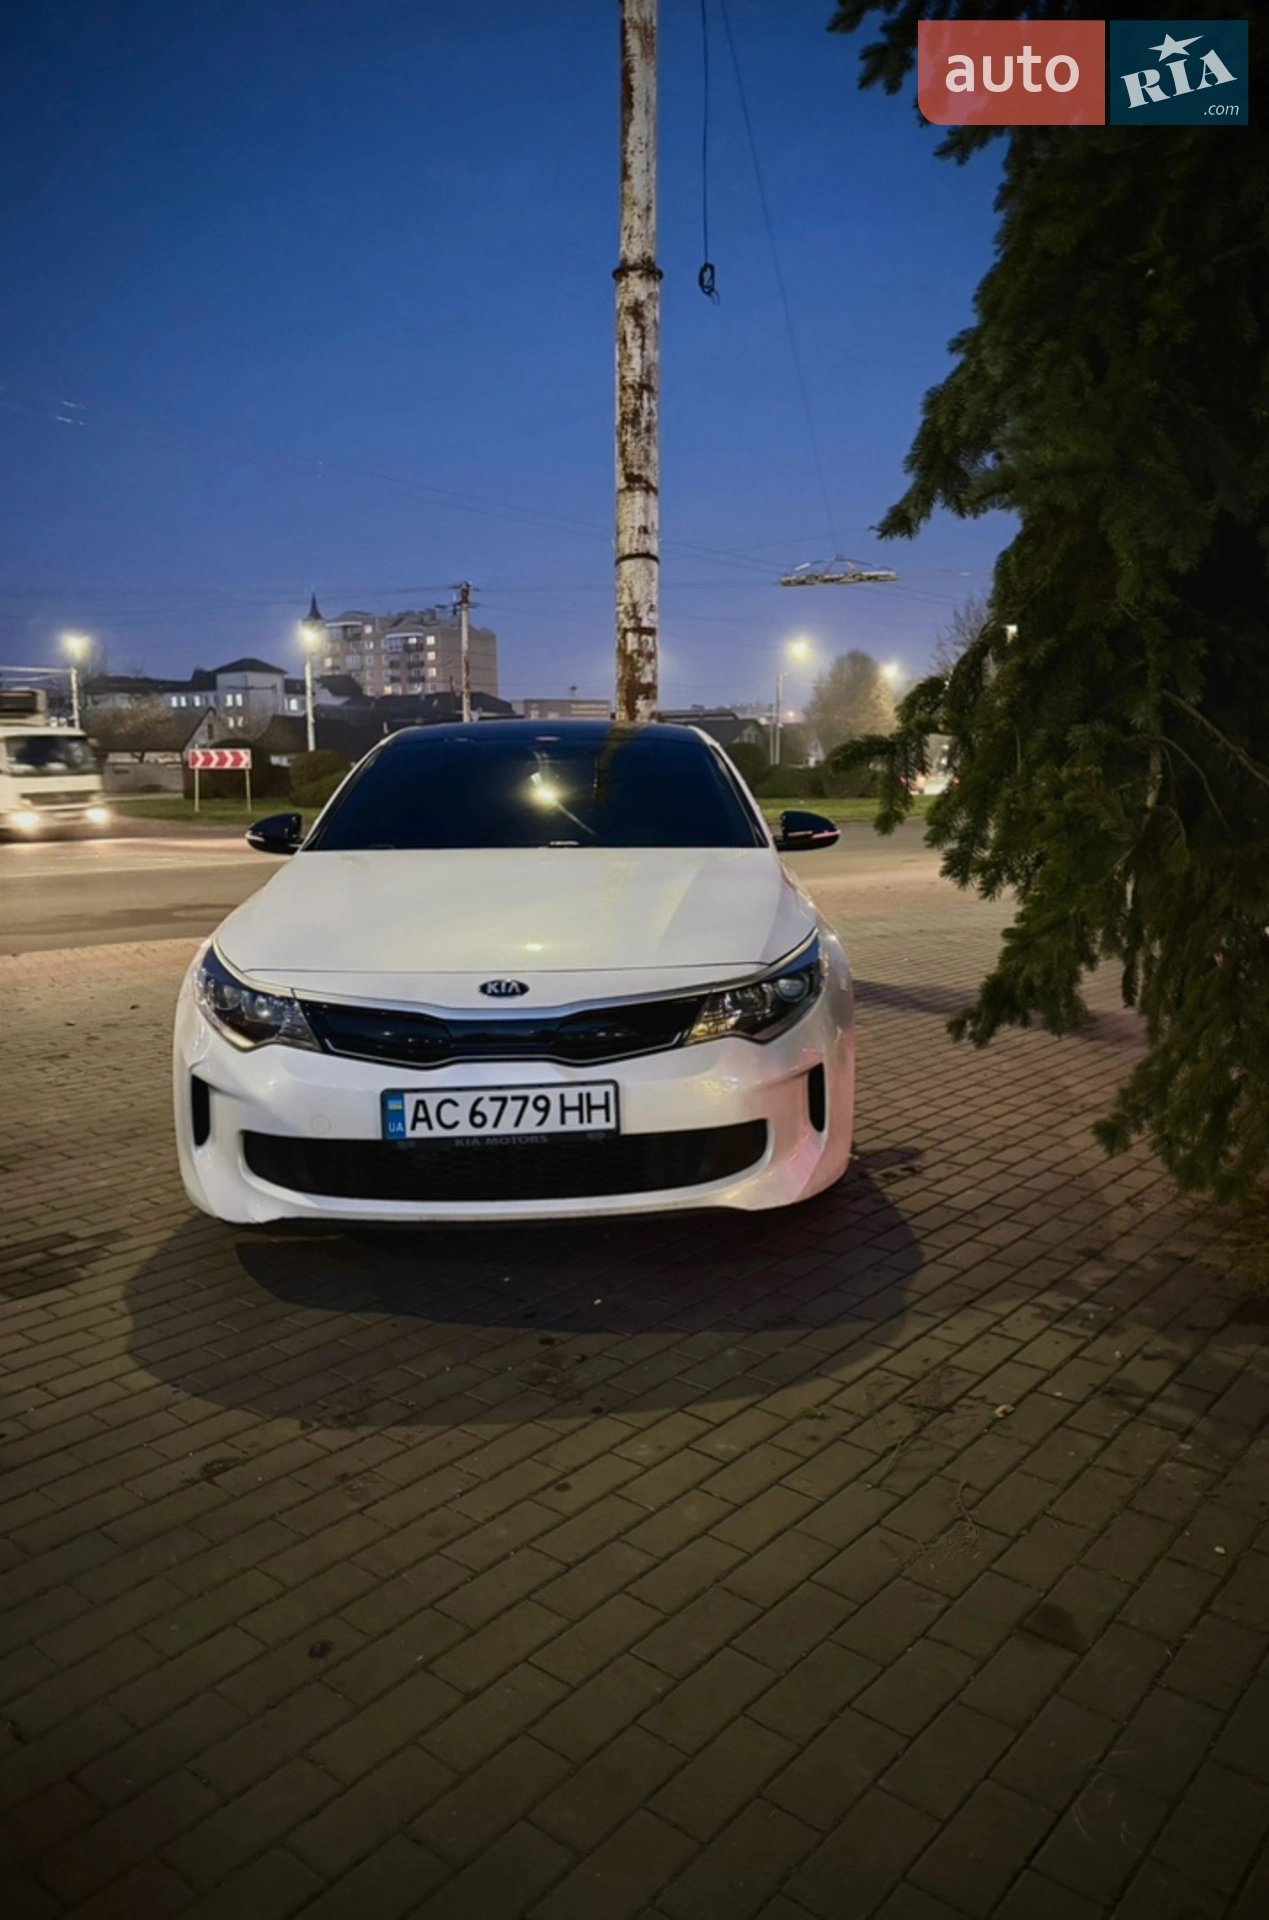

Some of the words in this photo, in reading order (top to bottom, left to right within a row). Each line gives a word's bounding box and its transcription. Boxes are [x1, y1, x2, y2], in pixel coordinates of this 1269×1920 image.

[487, 982, 520, 994] KIA
[410, 1098, 460, 1131] AC
[469, 1094, 550, 1129] 6779
[560, 1091, 610, 1126] HH
[388, 1121, 405, 1133] UA
[454, 1137, 481, 1147] KIA
[484, 1134, 548, 1146] MOTORS
